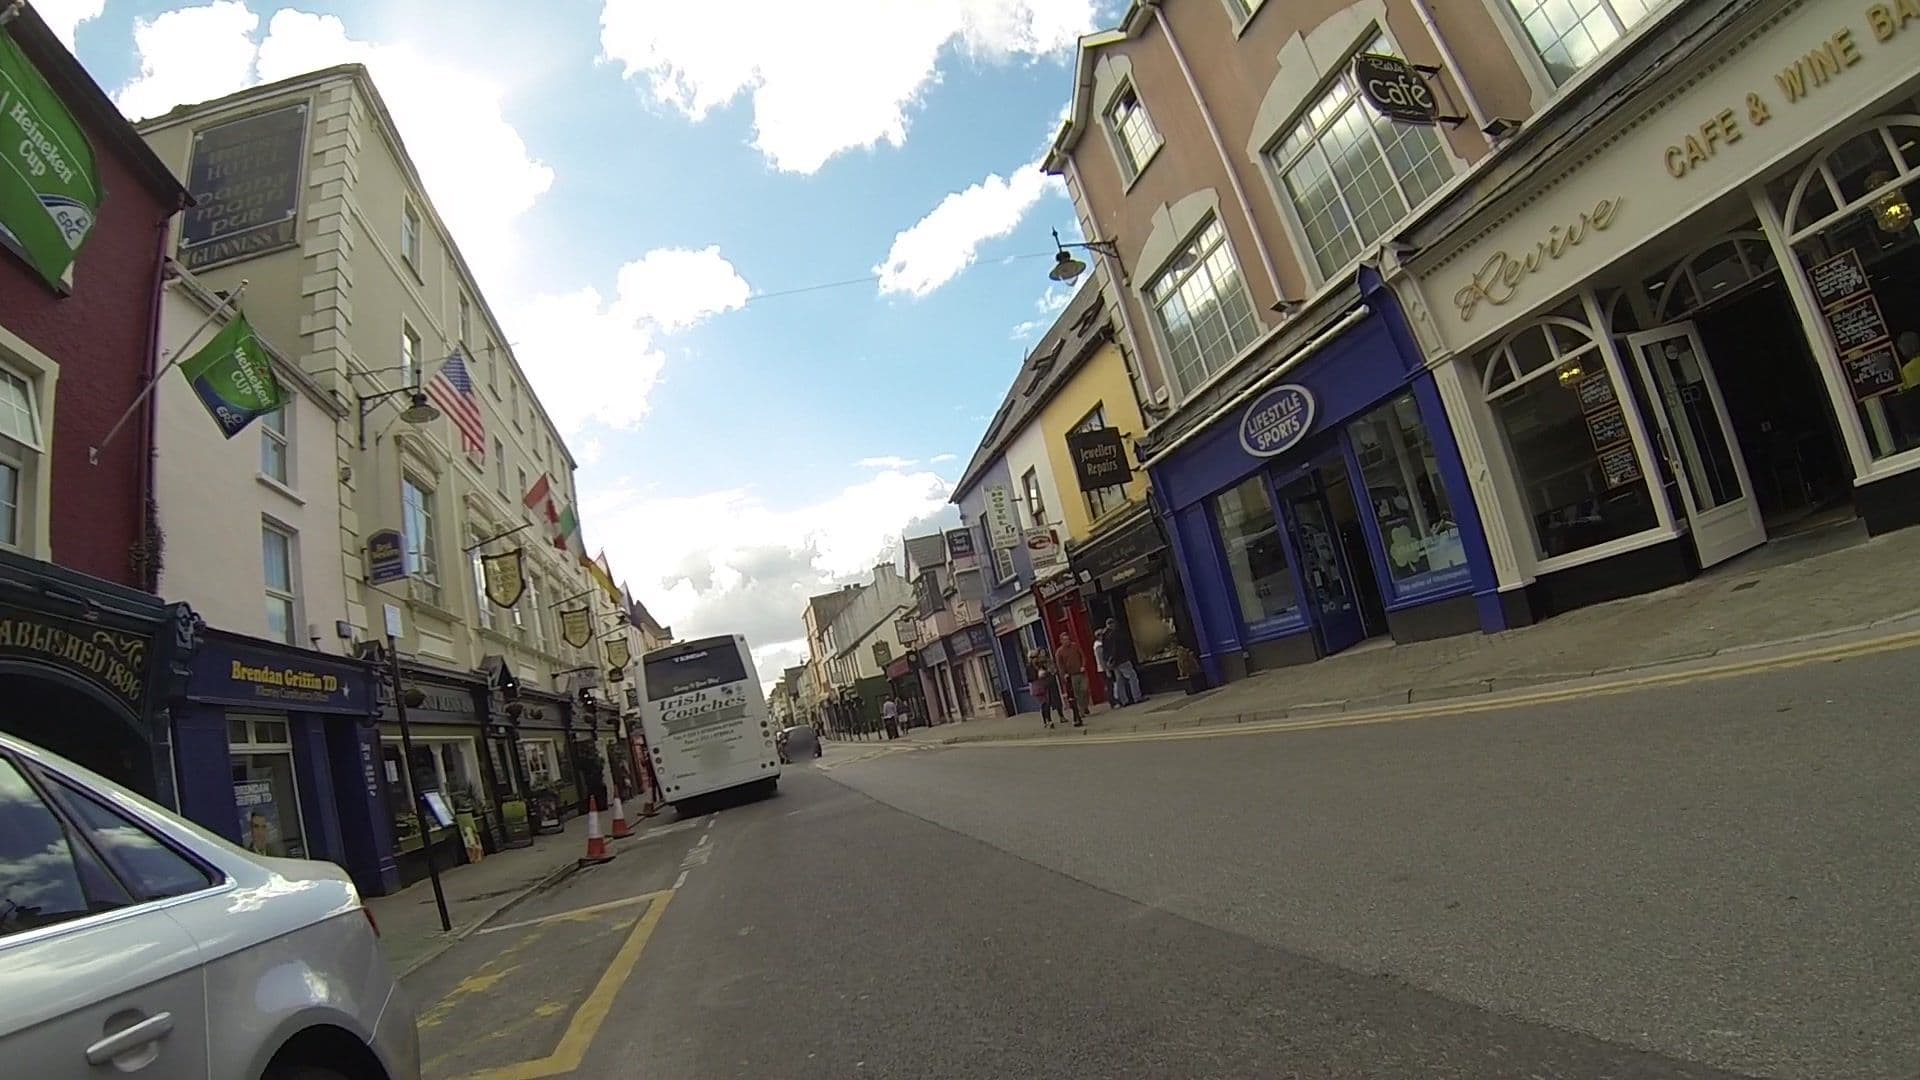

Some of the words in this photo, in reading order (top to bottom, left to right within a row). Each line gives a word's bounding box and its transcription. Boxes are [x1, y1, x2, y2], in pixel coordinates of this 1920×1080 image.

[9, 101, 74, 185] Heineken
[20, 139, 46, 176] Cup
[1454, 193, 1623, 322] Revive
[1664, 107, 1742, 178] CAFE
[1746, 92, 1772, 126] &
[1774, 26, 1861, 104] WINE
[192, 232, 273, 264] GUINNESS
[234, 347, 272, 407] Heineken
[1247, 391, 1301, 435] LIFESTYLE
[1257, 415, 1300, 450] SPORTS
[1080, 444, 1117, 463] Jewellery
[1087, 459, 1118, 477] Repairs
[231, 660, 283, 686] Brendan
[284, 669, 322, 690] Griffin
[322, 675, 338, 692] TD
[659, 692, 706, 712] Irish
[661, 695, 747, 722] Coaches
